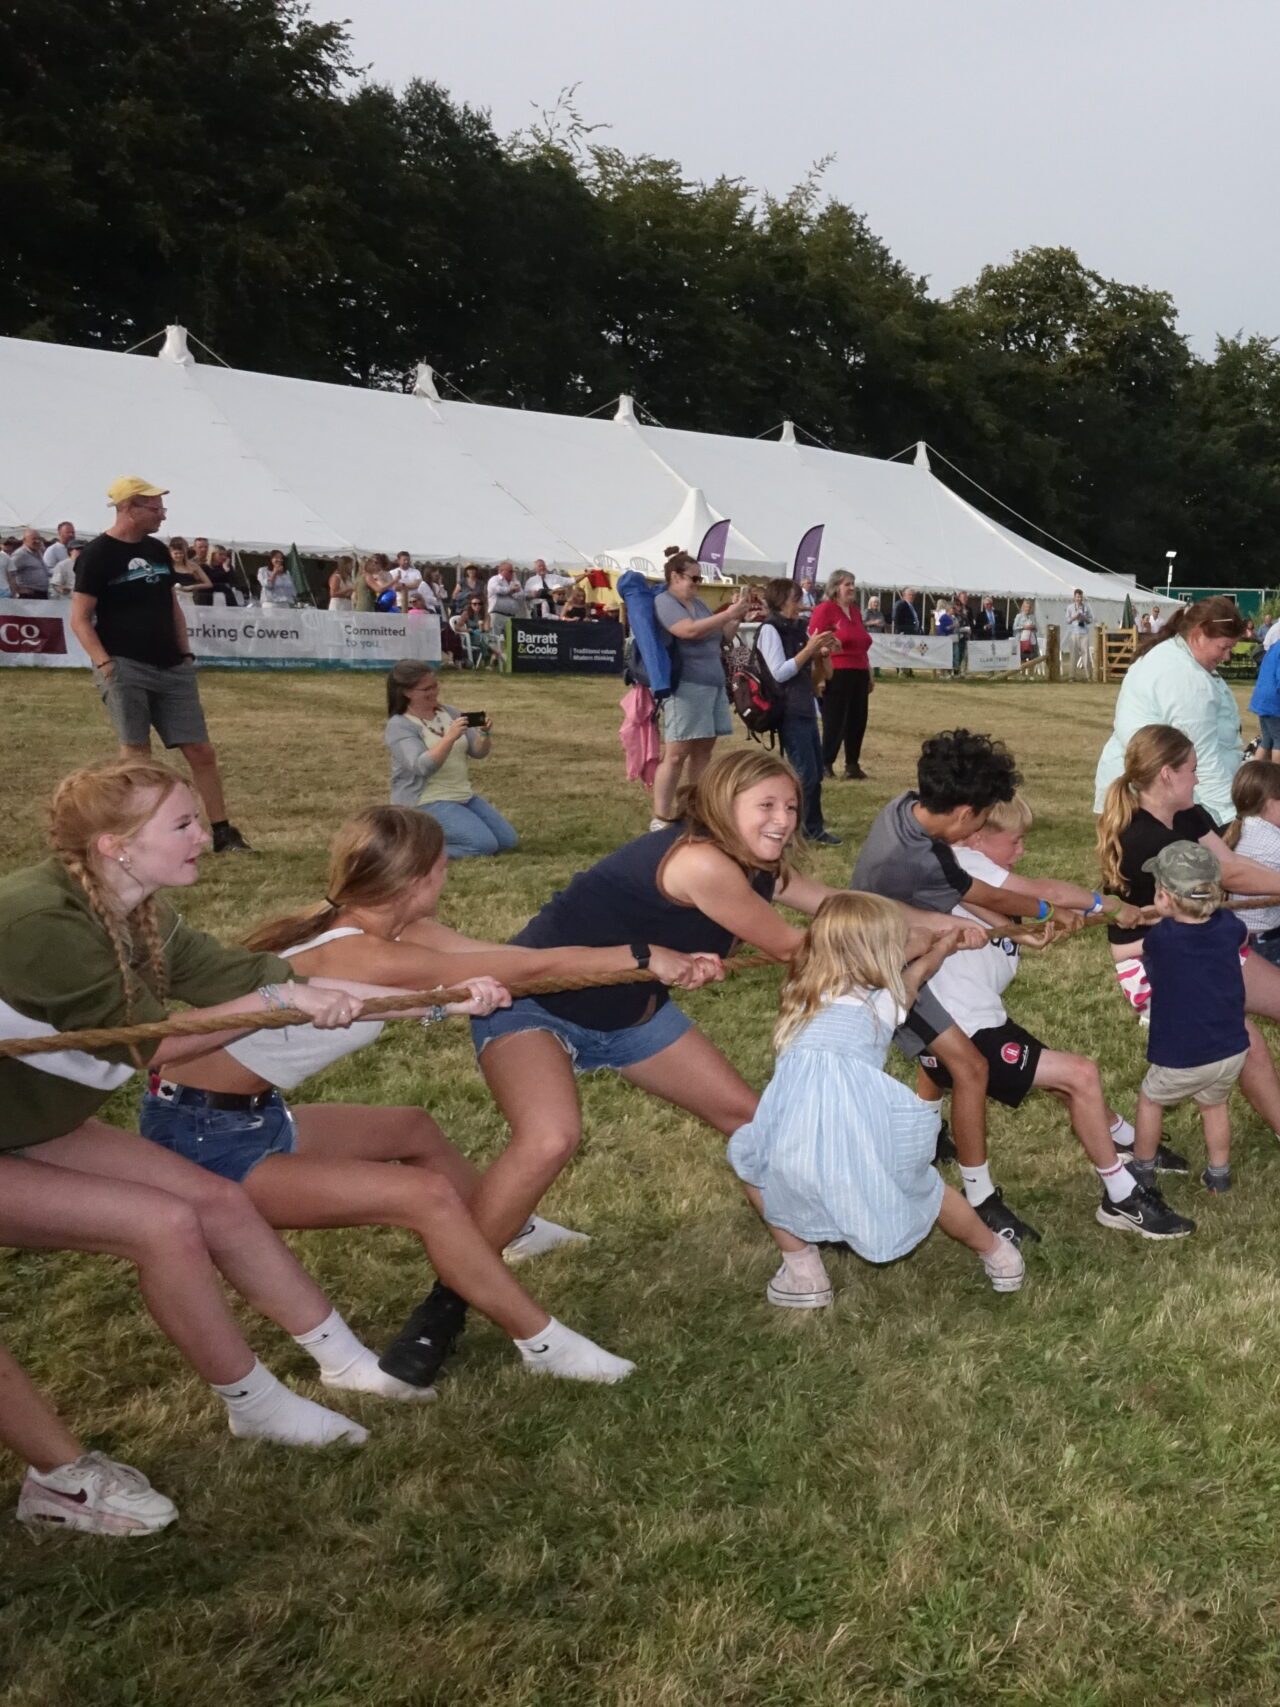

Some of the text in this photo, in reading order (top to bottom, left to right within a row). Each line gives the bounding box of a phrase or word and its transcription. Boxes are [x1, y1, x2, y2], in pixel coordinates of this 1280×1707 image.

[186, 623, 238, 642] arking
[344, 624, 406, 637] Committed
[517, 630, 559, 644] Barratt
[345, 638, 358, 648] to
[517, 643, 558, 655] &Cooke
